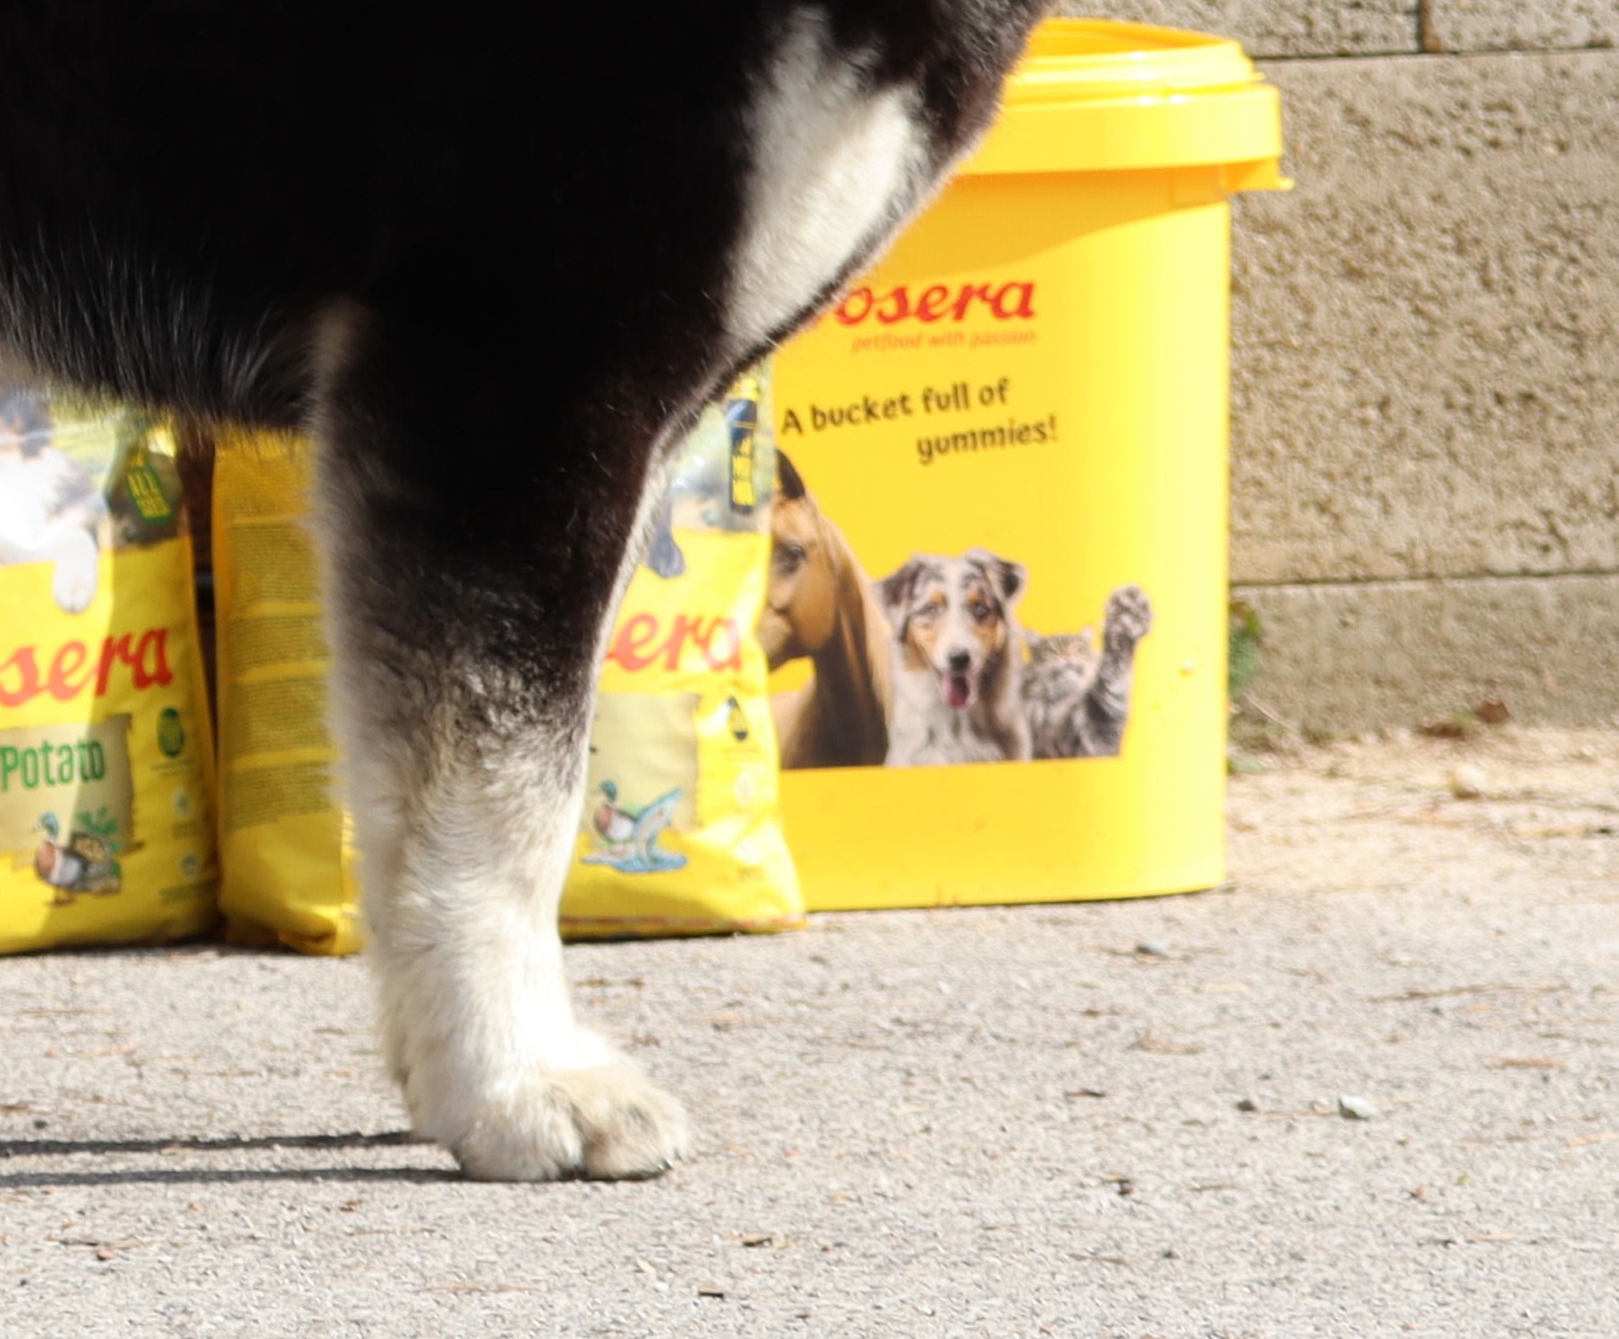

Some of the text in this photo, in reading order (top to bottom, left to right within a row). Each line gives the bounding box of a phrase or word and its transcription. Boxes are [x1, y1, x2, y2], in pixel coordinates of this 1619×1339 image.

[832, 280, 1037, 328] osera
[927, 331, 965, 348] with
[969, 330, 1036, 350] passion
[780, 377, 1010, 436] A bucket full of
[916, 414, 1060, 465] yummies!
[608, 613, 743, 673] era
[0, 738, 106, 793] Potato
